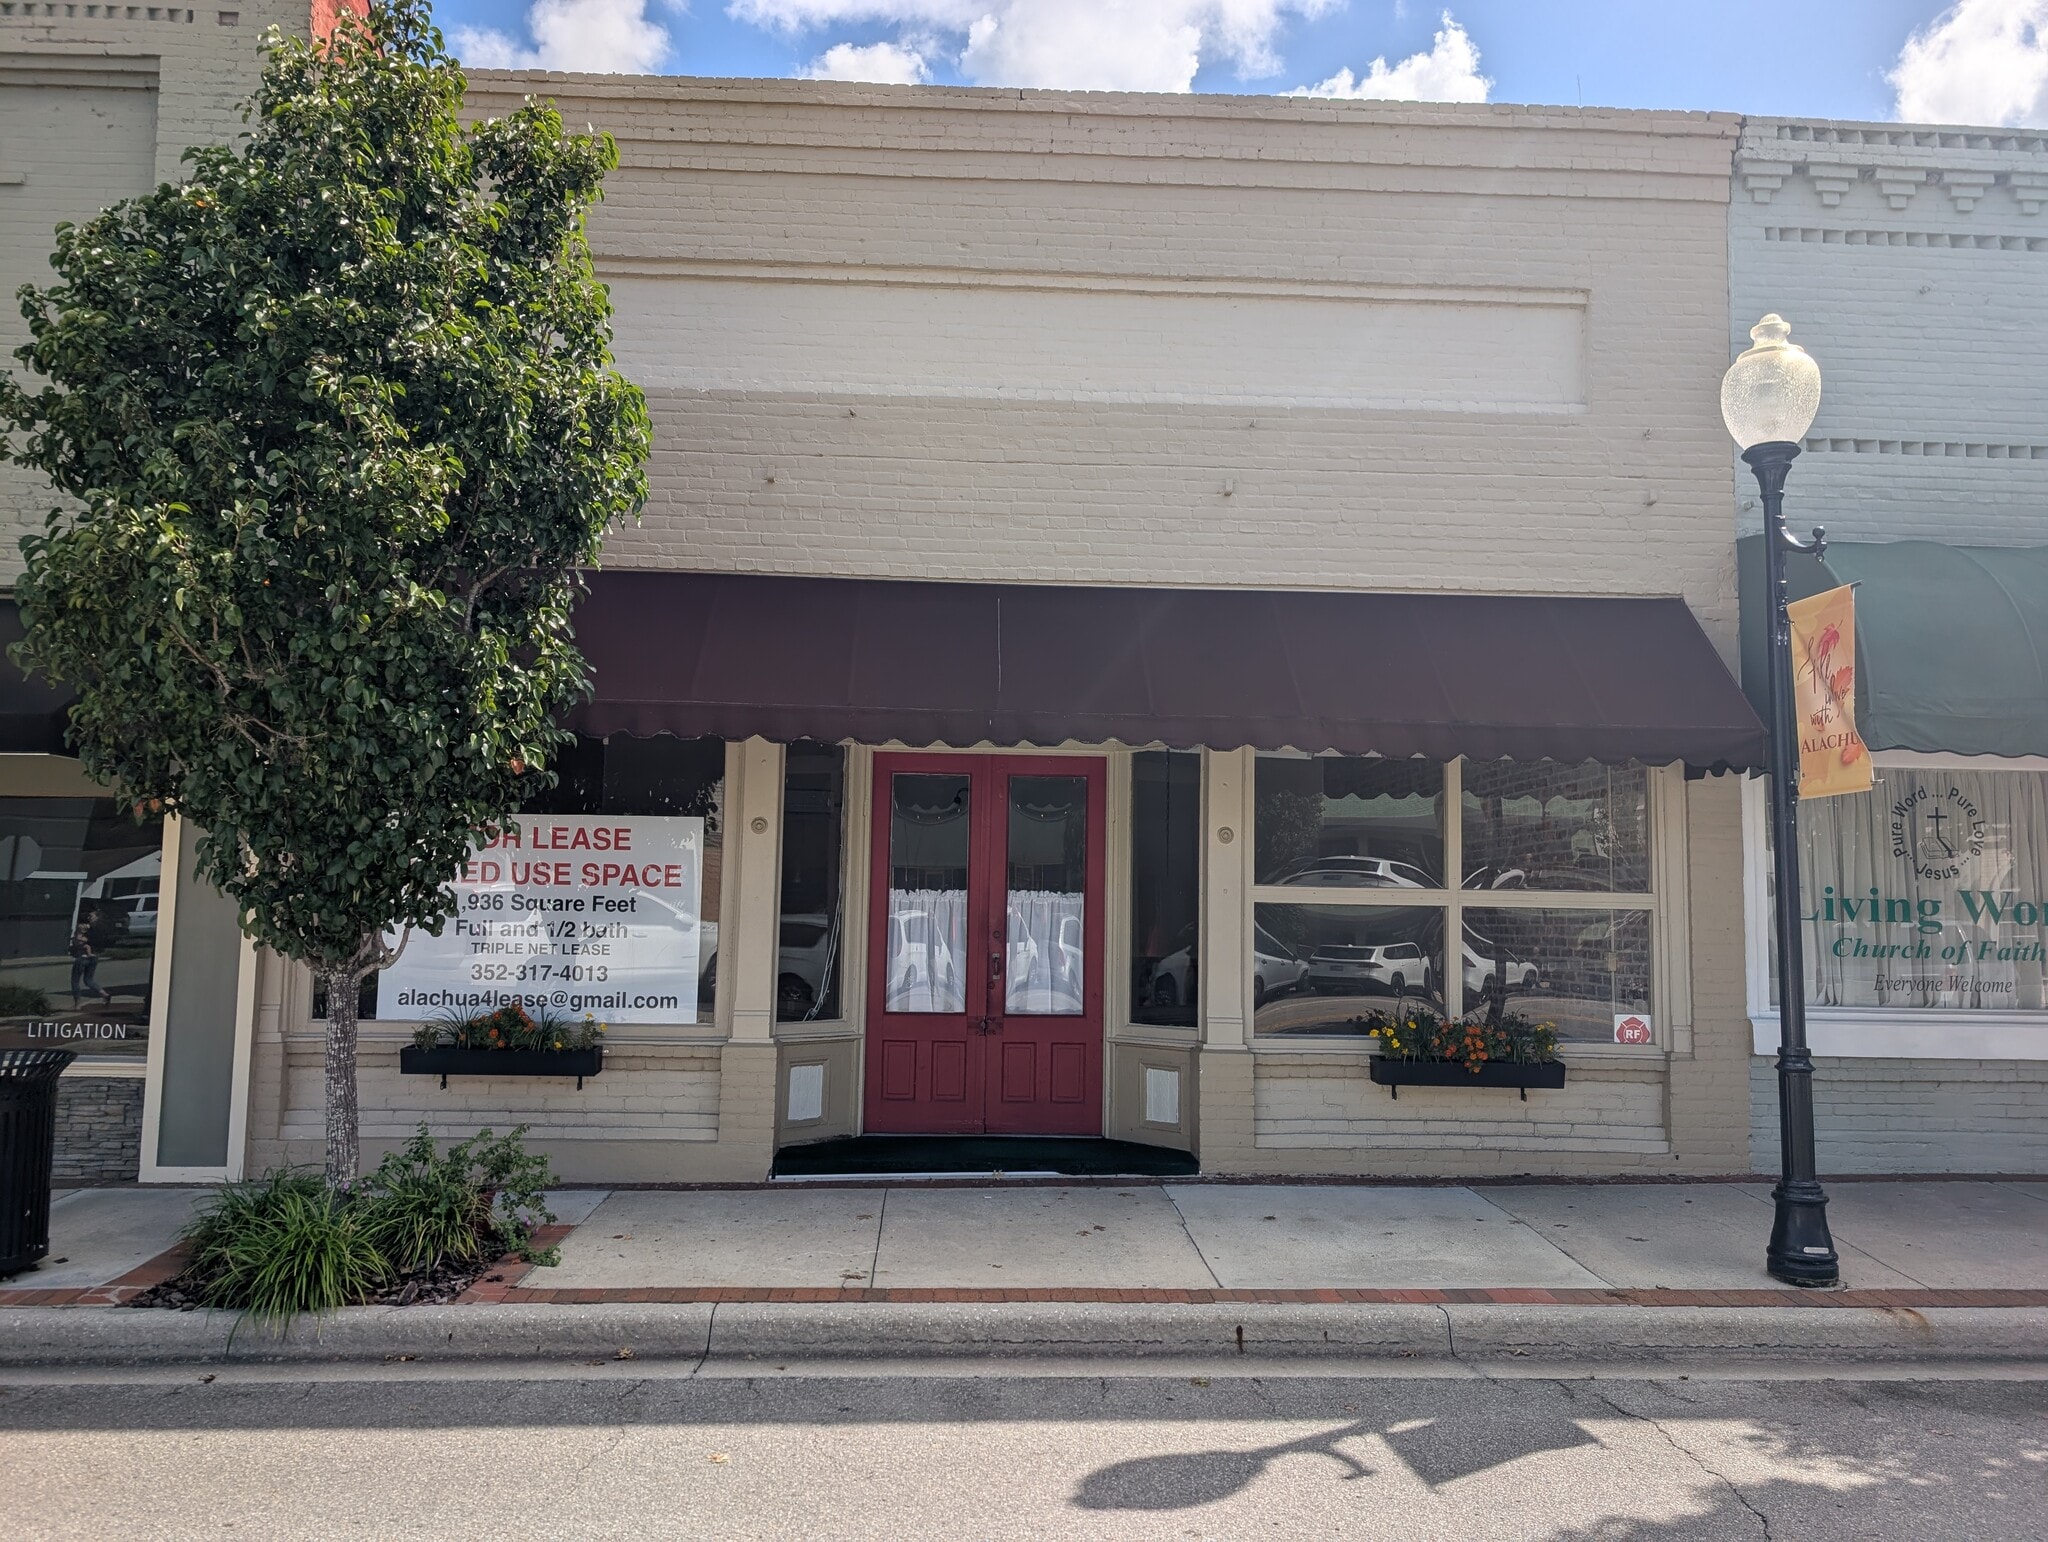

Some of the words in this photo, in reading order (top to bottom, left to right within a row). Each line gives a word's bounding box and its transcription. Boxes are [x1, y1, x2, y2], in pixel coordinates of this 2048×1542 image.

[1891, 785, 1928, 818] Word
[1947, 786, 1978, 818] Pure
[469, 824, 522, 849] OR
[532, 827, 632, 850] LEASE
[1891, 821, 1908, 858] Pure
[1970, 820, 1986, 857] Love
[511, 862, 572, 886] USE
[581, 864, 682, 887] SPACE
[1916, 863, 1960, 880] Jesus
[510, 893, 585, 912] Square
[592, 896, 637, 912] Feet
[455, 919, 493, 936] Full
[500, 921, 539, 938] and
[547, 921, 576, 938] 1/2
[582, 922, 628, 939] bath
[471, 942, 524, 955] TRIPLE
[528, 943, 558, 955] NET
[562, 943, 611, 956] LEASE
[1833, 937, 1930, 960] Church
[1941, 940, 1972, 966] of
[1977, 940, 2047, 962] Faith
[471, 963, 609, 982] 352-317-4013
[1874, 974, 1943, 995] Everyone
[1949, 975, 2012, 993] Welcome
[397, 989, 678, 1012] alachua4lease@gmail.com
[27, 1022, 126, 1039] LITIGATION
[1626, 1029, 1641, 1039] RF
